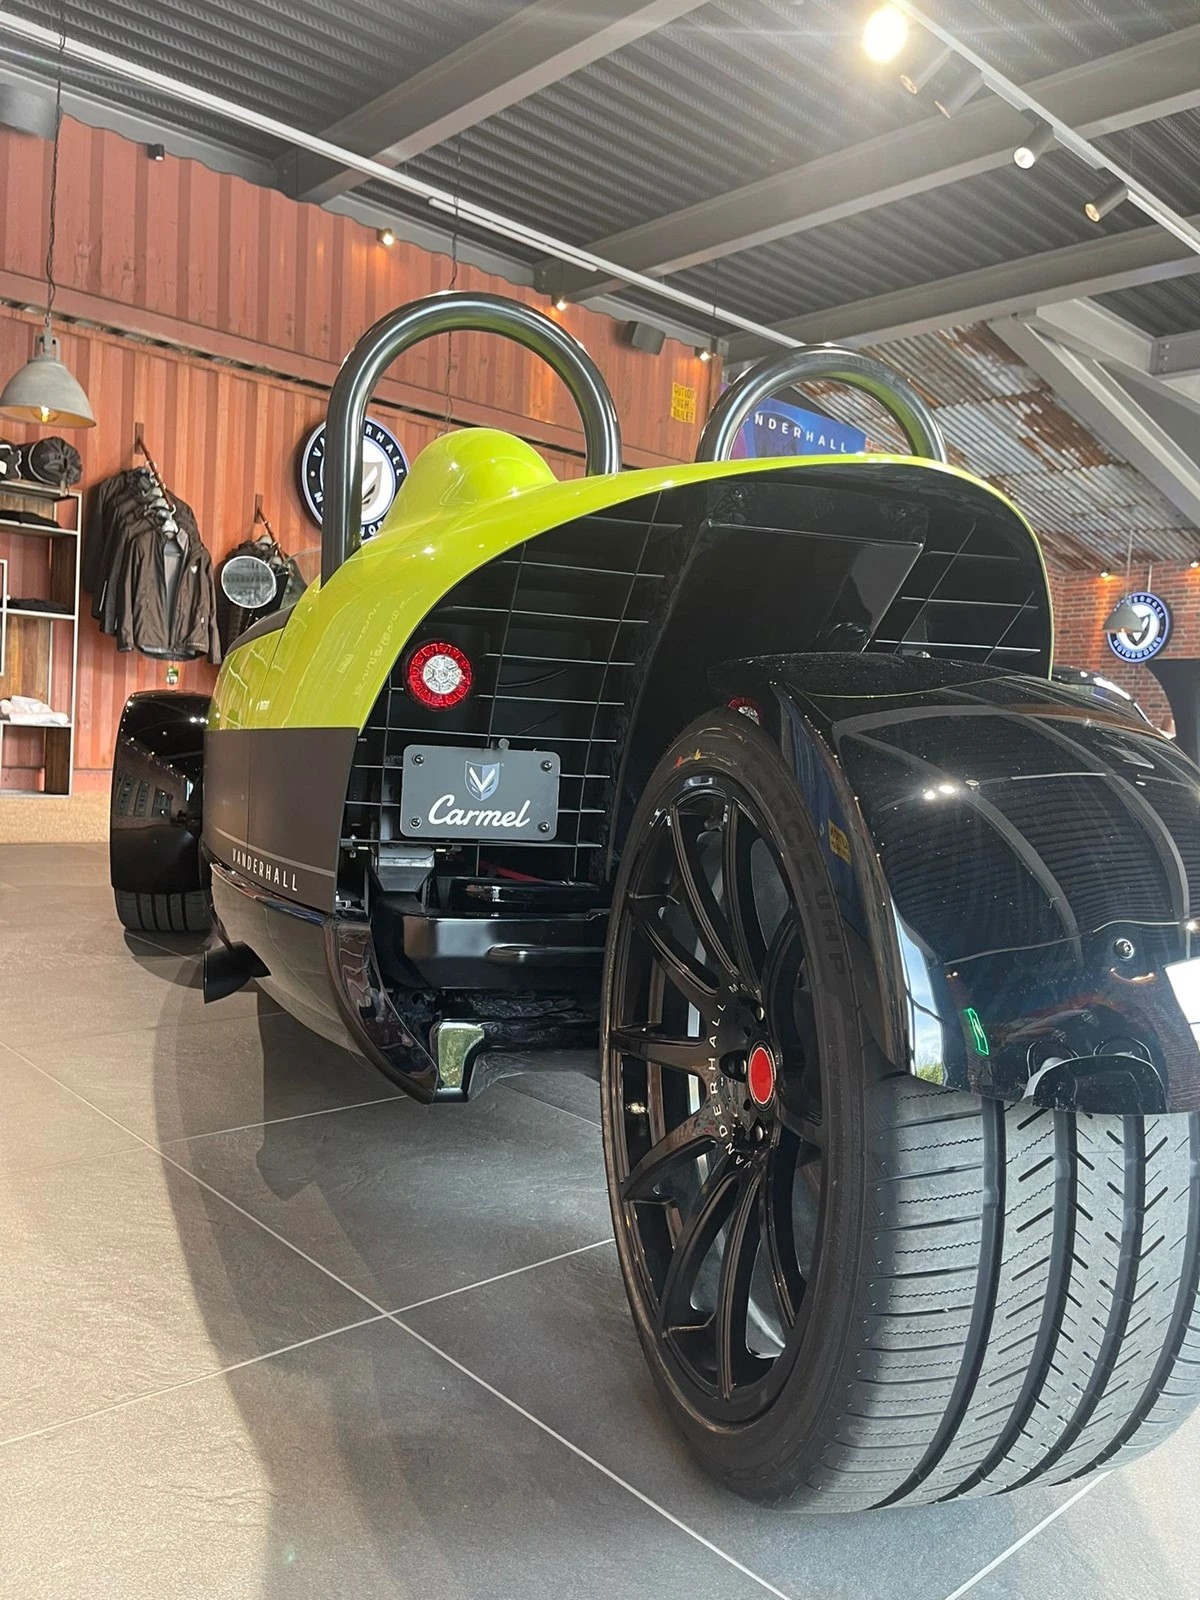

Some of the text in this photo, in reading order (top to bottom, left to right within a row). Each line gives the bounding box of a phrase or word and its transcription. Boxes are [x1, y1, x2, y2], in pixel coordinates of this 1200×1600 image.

[312, 424, 404, 477] VRHALL
[746, 412, 846, 453] NDERHALL
[428, 794, 531, 828] Carmel
[231, 847, 298, 892] VANDERHALL
